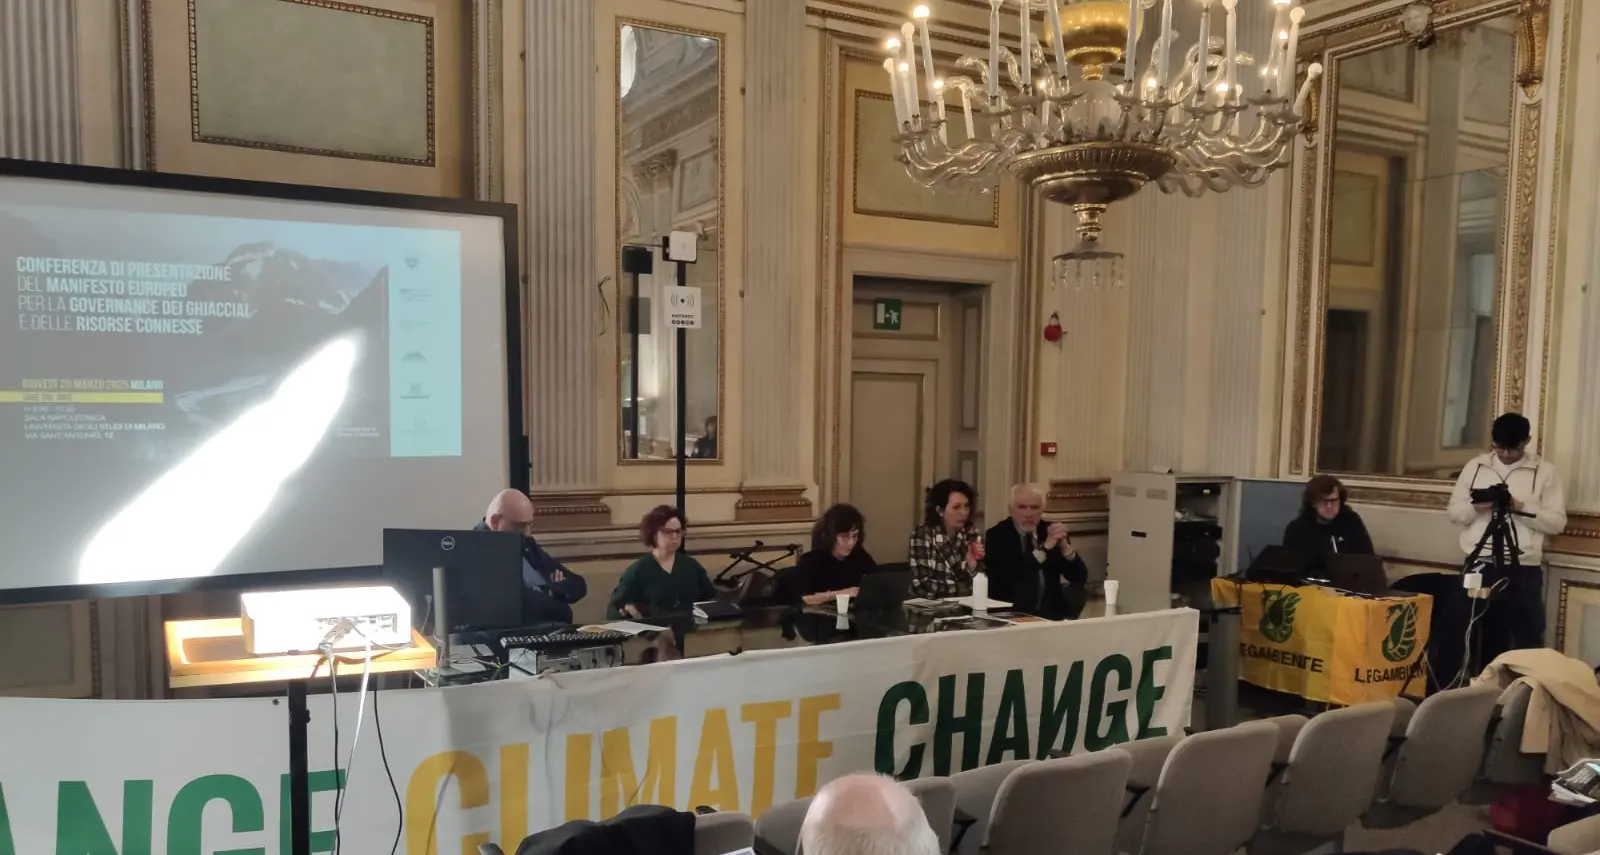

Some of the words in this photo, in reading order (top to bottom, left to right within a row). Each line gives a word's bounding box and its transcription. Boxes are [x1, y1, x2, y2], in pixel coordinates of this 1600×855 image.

[16, 256, 107, 275] CONFERENZA
[110, 260, 125, 276] DI
[127, 261, 232, 281] PRESENTAZIONE
[17, 275, 44, 292] DEL
[46, 276, 125, 296] MANIFESTO
[127, 280, 188, 298] EUROPEO
[18, 294, 45, 311] PER
[48, 296, 67, 312] LA
[69, 296, 160, 315] GOVERNANCE
[162, 299, 183, 316] DEI
[19, 313, 28, 331] E
[31, 314, 74, 331] DELLE
[76, 316, 133, 332] RISORSE
[136, 318, 204, 335] CONNESSE
[130, 379, 163, 390] MILANO
